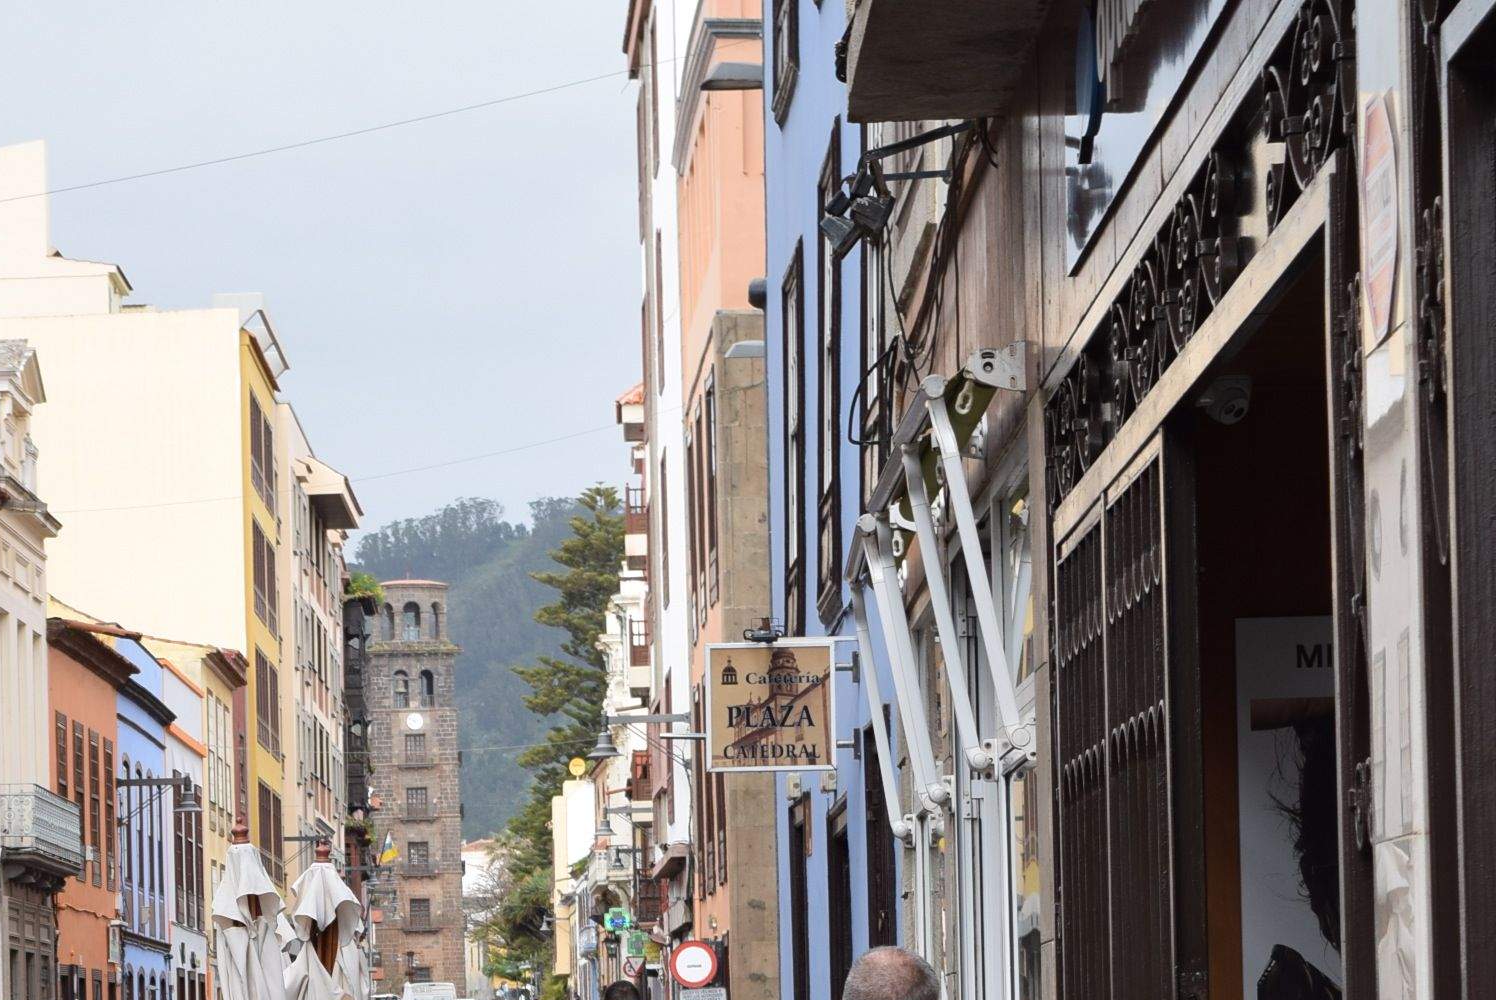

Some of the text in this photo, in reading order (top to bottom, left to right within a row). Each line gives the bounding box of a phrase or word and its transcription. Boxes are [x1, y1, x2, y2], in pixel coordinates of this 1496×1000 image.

[745, 671, 820, 685] Cafetería
[726, 705, 815, 728] PLAZA
[723, 742, 821, 759] CATEDRAL
